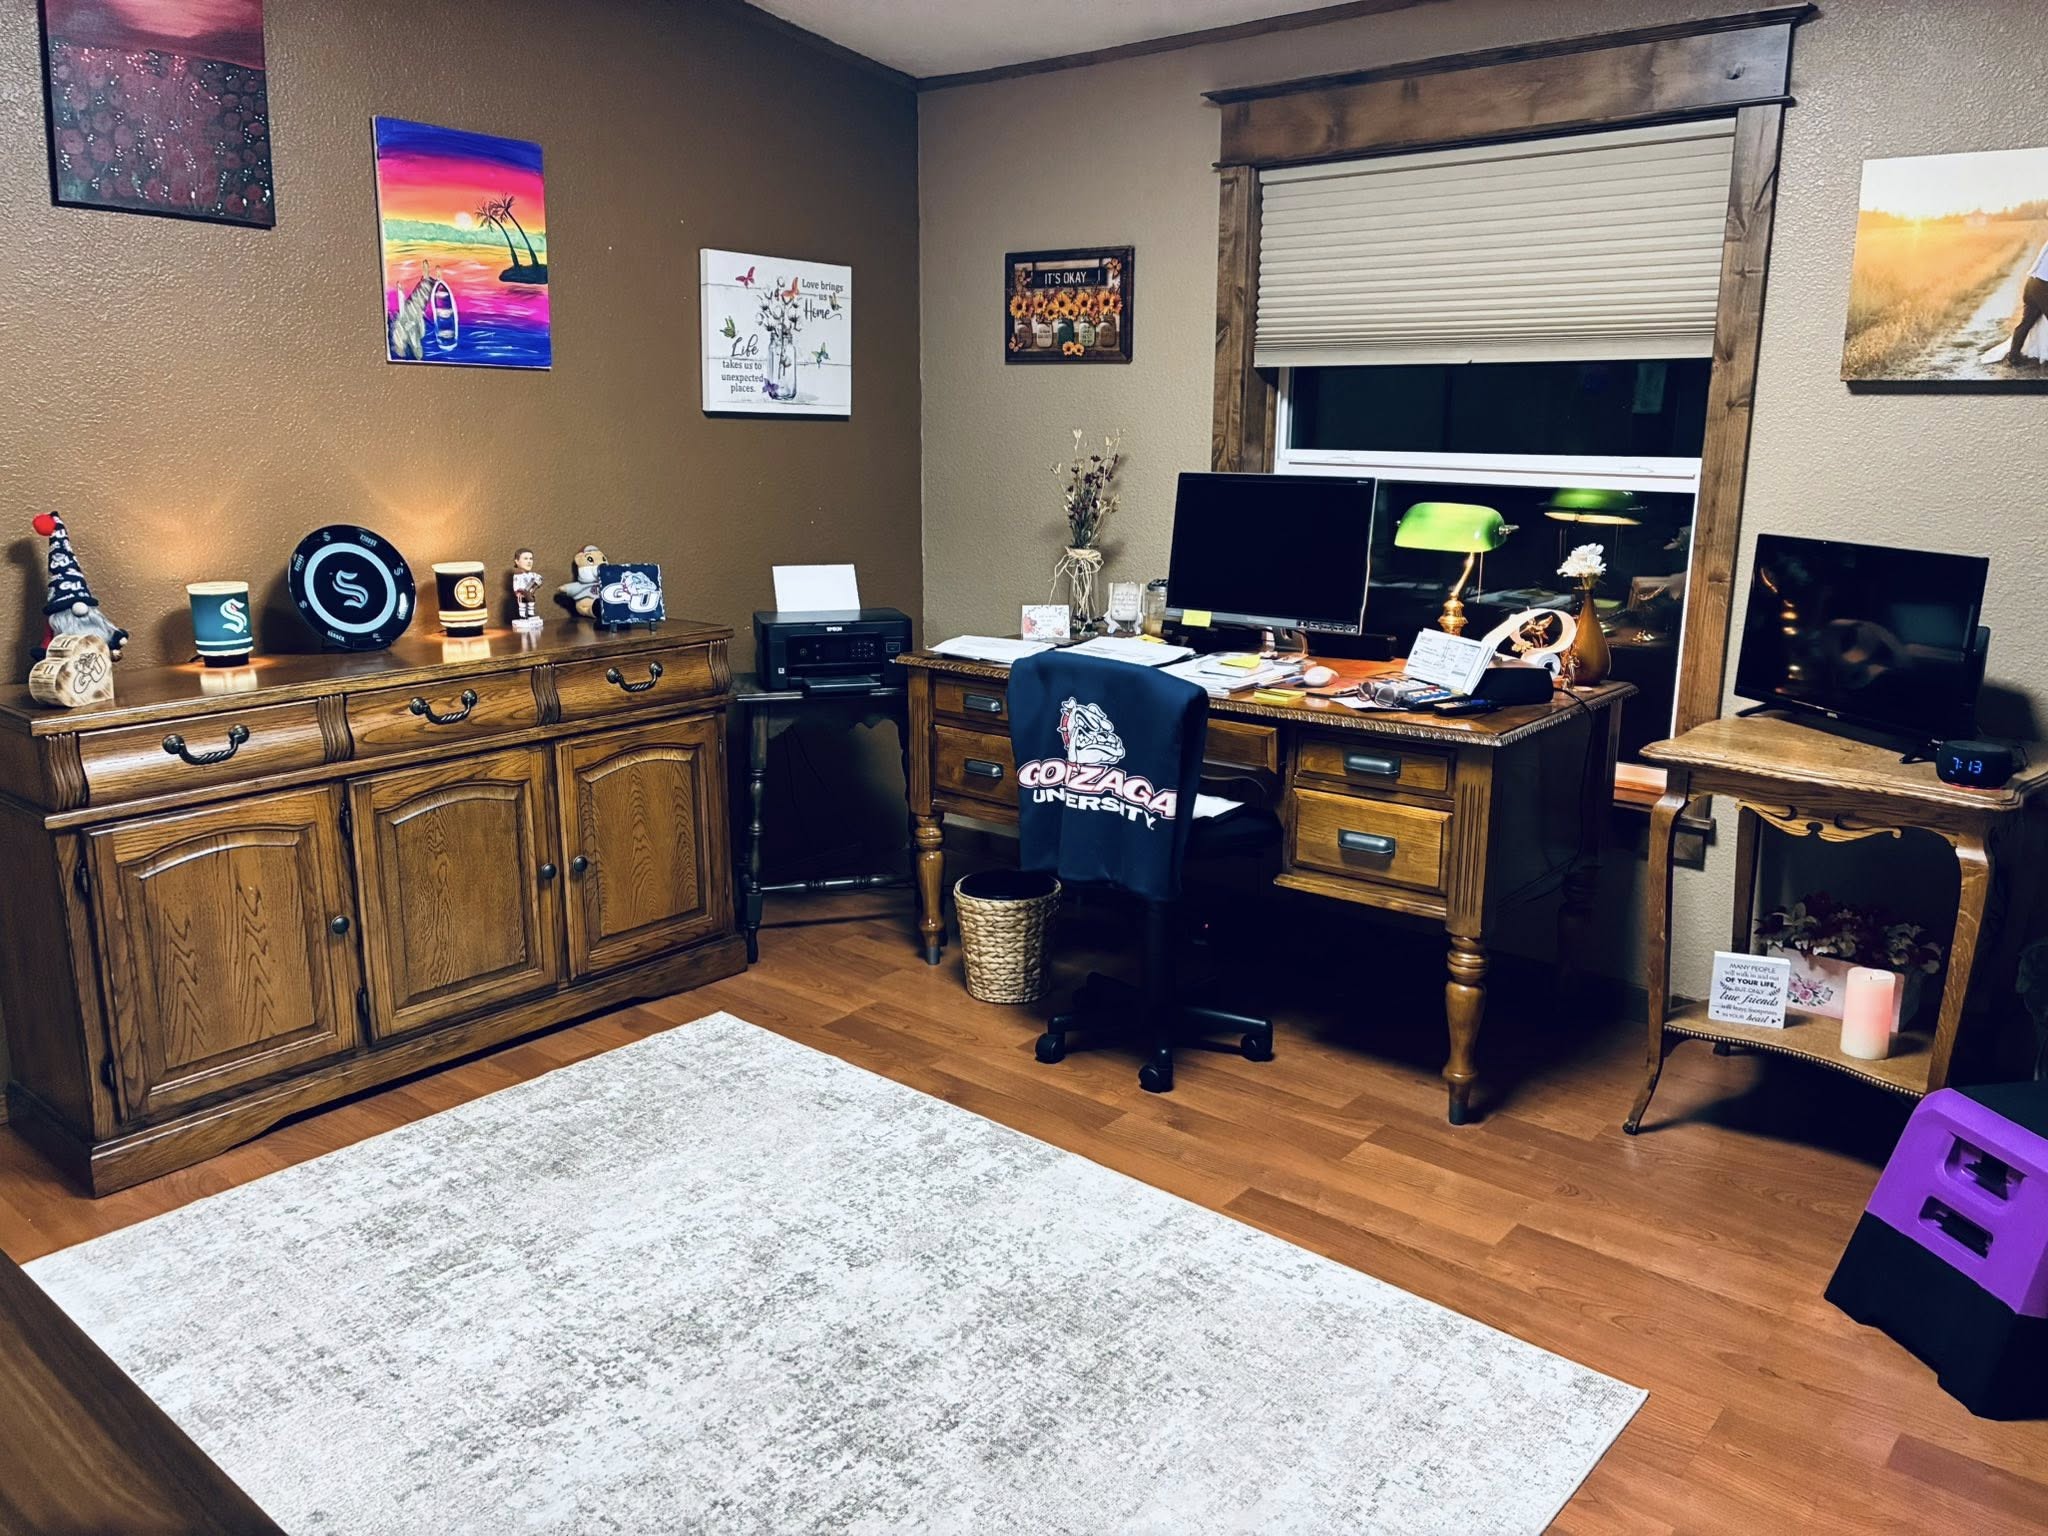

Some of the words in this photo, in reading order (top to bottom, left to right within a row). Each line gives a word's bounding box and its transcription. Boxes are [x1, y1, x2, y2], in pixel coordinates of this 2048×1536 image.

[1044, 273, 1060, 285] IT'S
[1063, 271, 1087, 284] OKAY
[802, 278, 819, 289] Love
[821, 281, 844, 293] brings
[803, 298, 842, 322] Home
[731, 334, 760, 357] Life
[722, 360, 742, 369] takes
[754, 362, 762, 370] to
[721, 373, 764, 384] unexpected
[466, 584, 477, 599] B
[1952, 756, 1983, 774] 7:13
[1751, 966, 1776, 974] PEOPLE
[1737, 978, 1758, 986] YOUR
[1760, 981, 1777, 989] LIFE,
[1720, 990, 1740, 1001] true
[1737, 994, 1778, 1007] friends
[1746, 1014, 1770, 1023] heart
